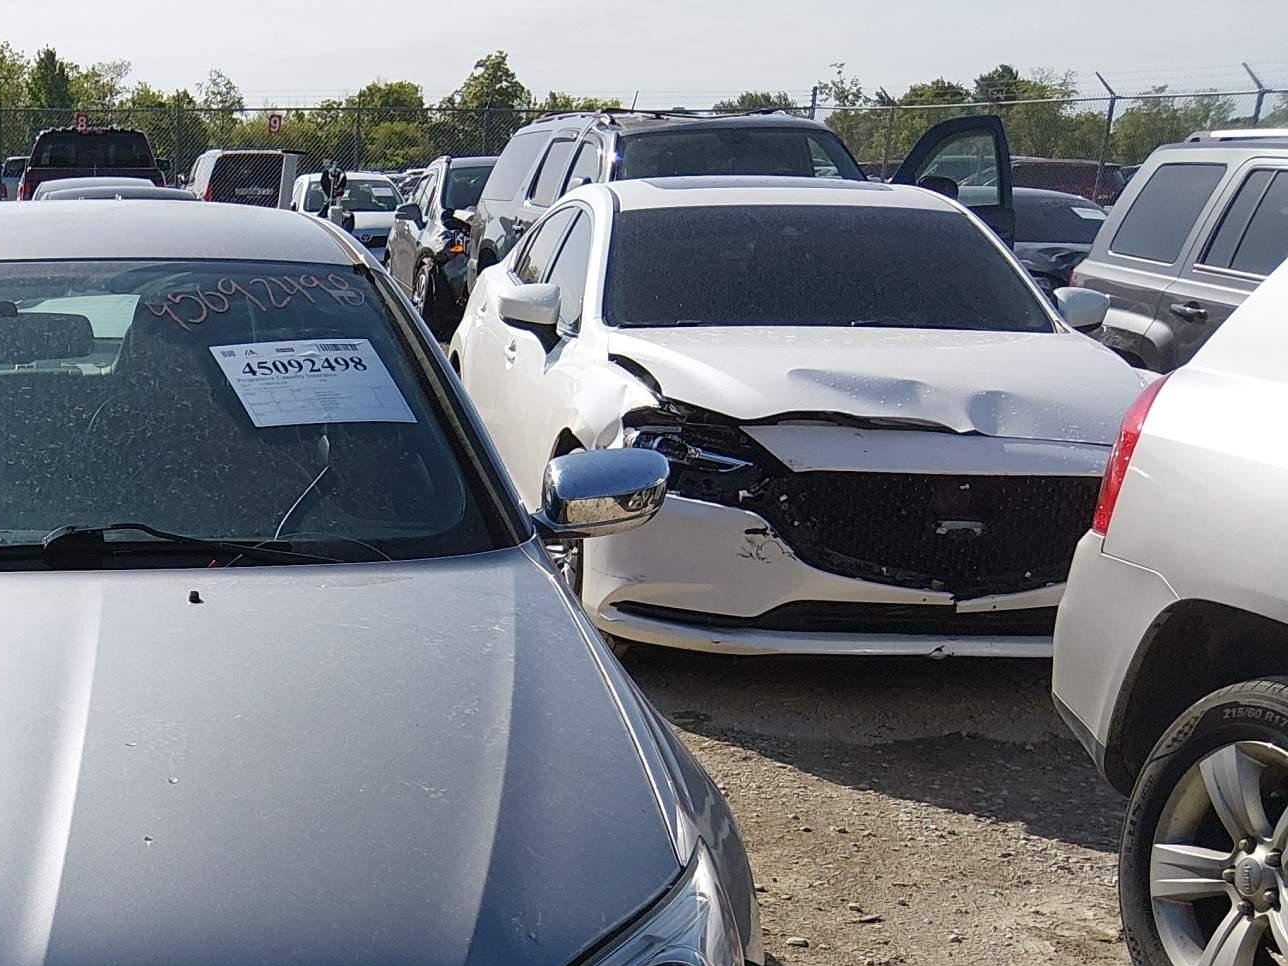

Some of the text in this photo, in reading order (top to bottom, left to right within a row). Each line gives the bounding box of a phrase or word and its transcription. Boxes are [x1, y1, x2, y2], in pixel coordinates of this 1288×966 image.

[78, 116, 87, 130] 8
[270, 117, 280, 131] 9
[242, 357, 367, 376] 45092498
